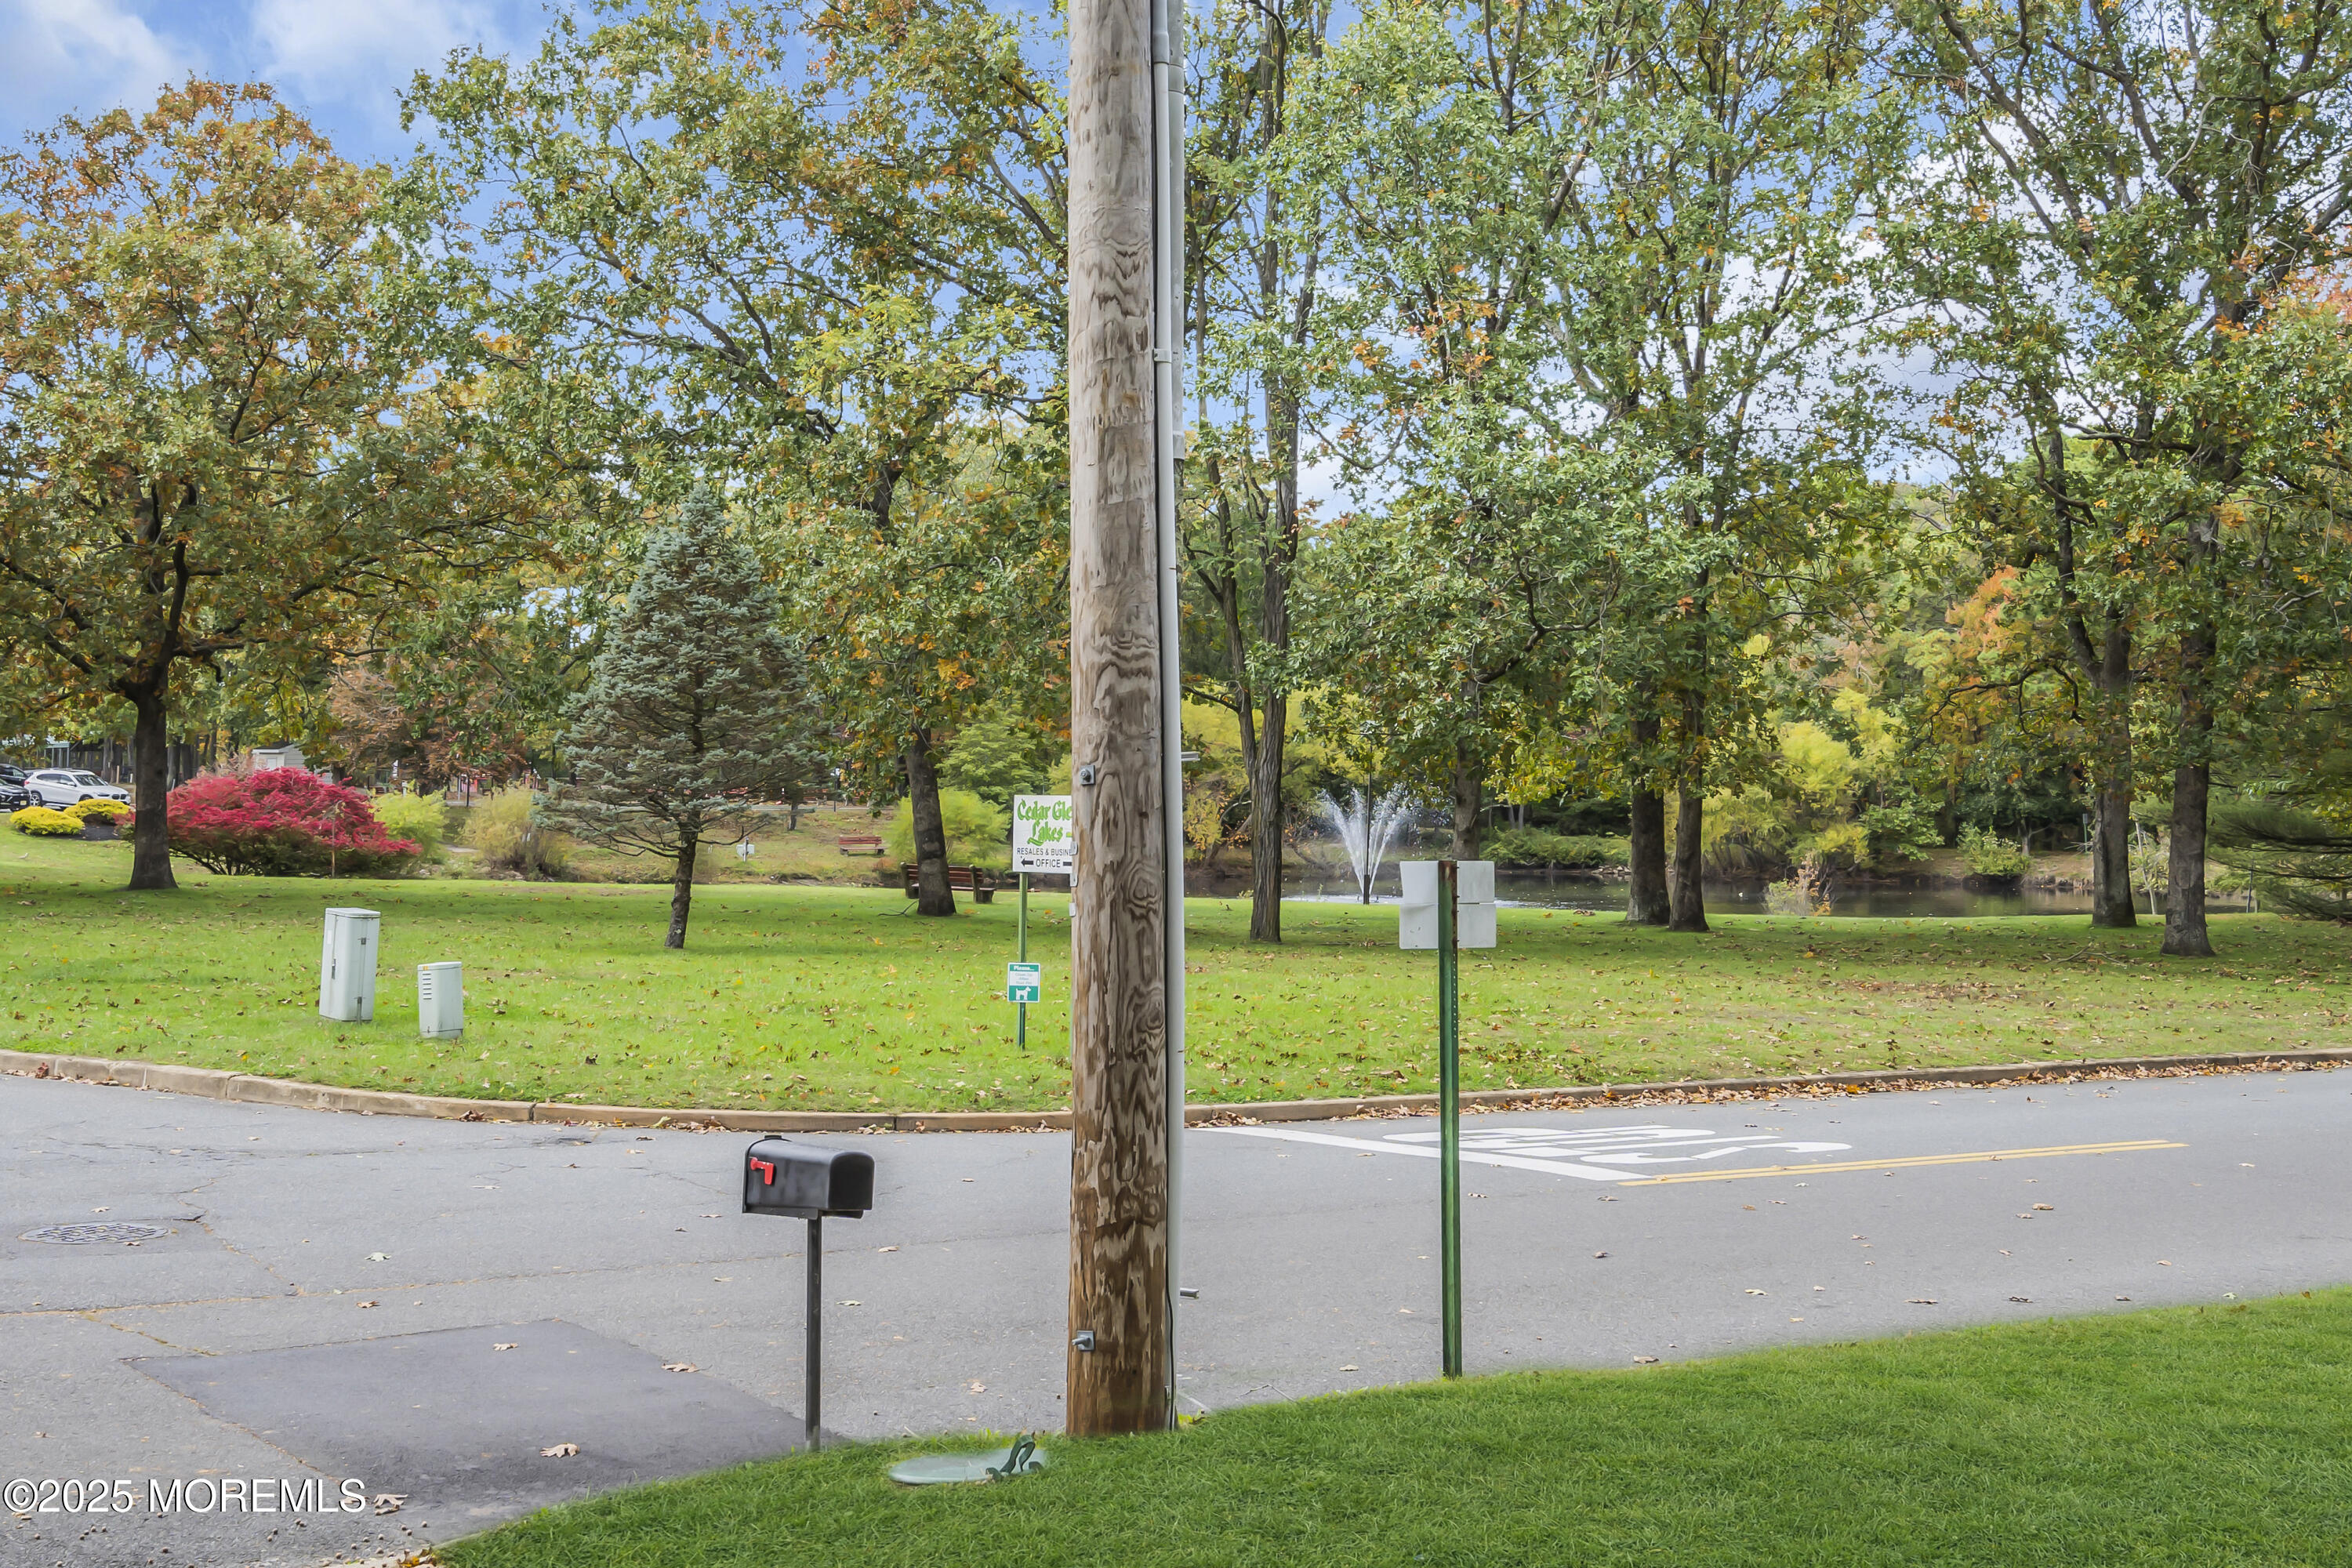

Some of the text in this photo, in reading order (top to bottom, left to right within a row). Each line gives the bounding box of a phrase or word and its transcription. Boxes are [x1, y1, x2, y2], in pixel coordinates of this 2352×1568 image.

[1017, 799, 1073, 821] Cedar Gle
[1027, 820, 1063, 847] Lakes
[1036, 858, 1061, 868] OFFICE
